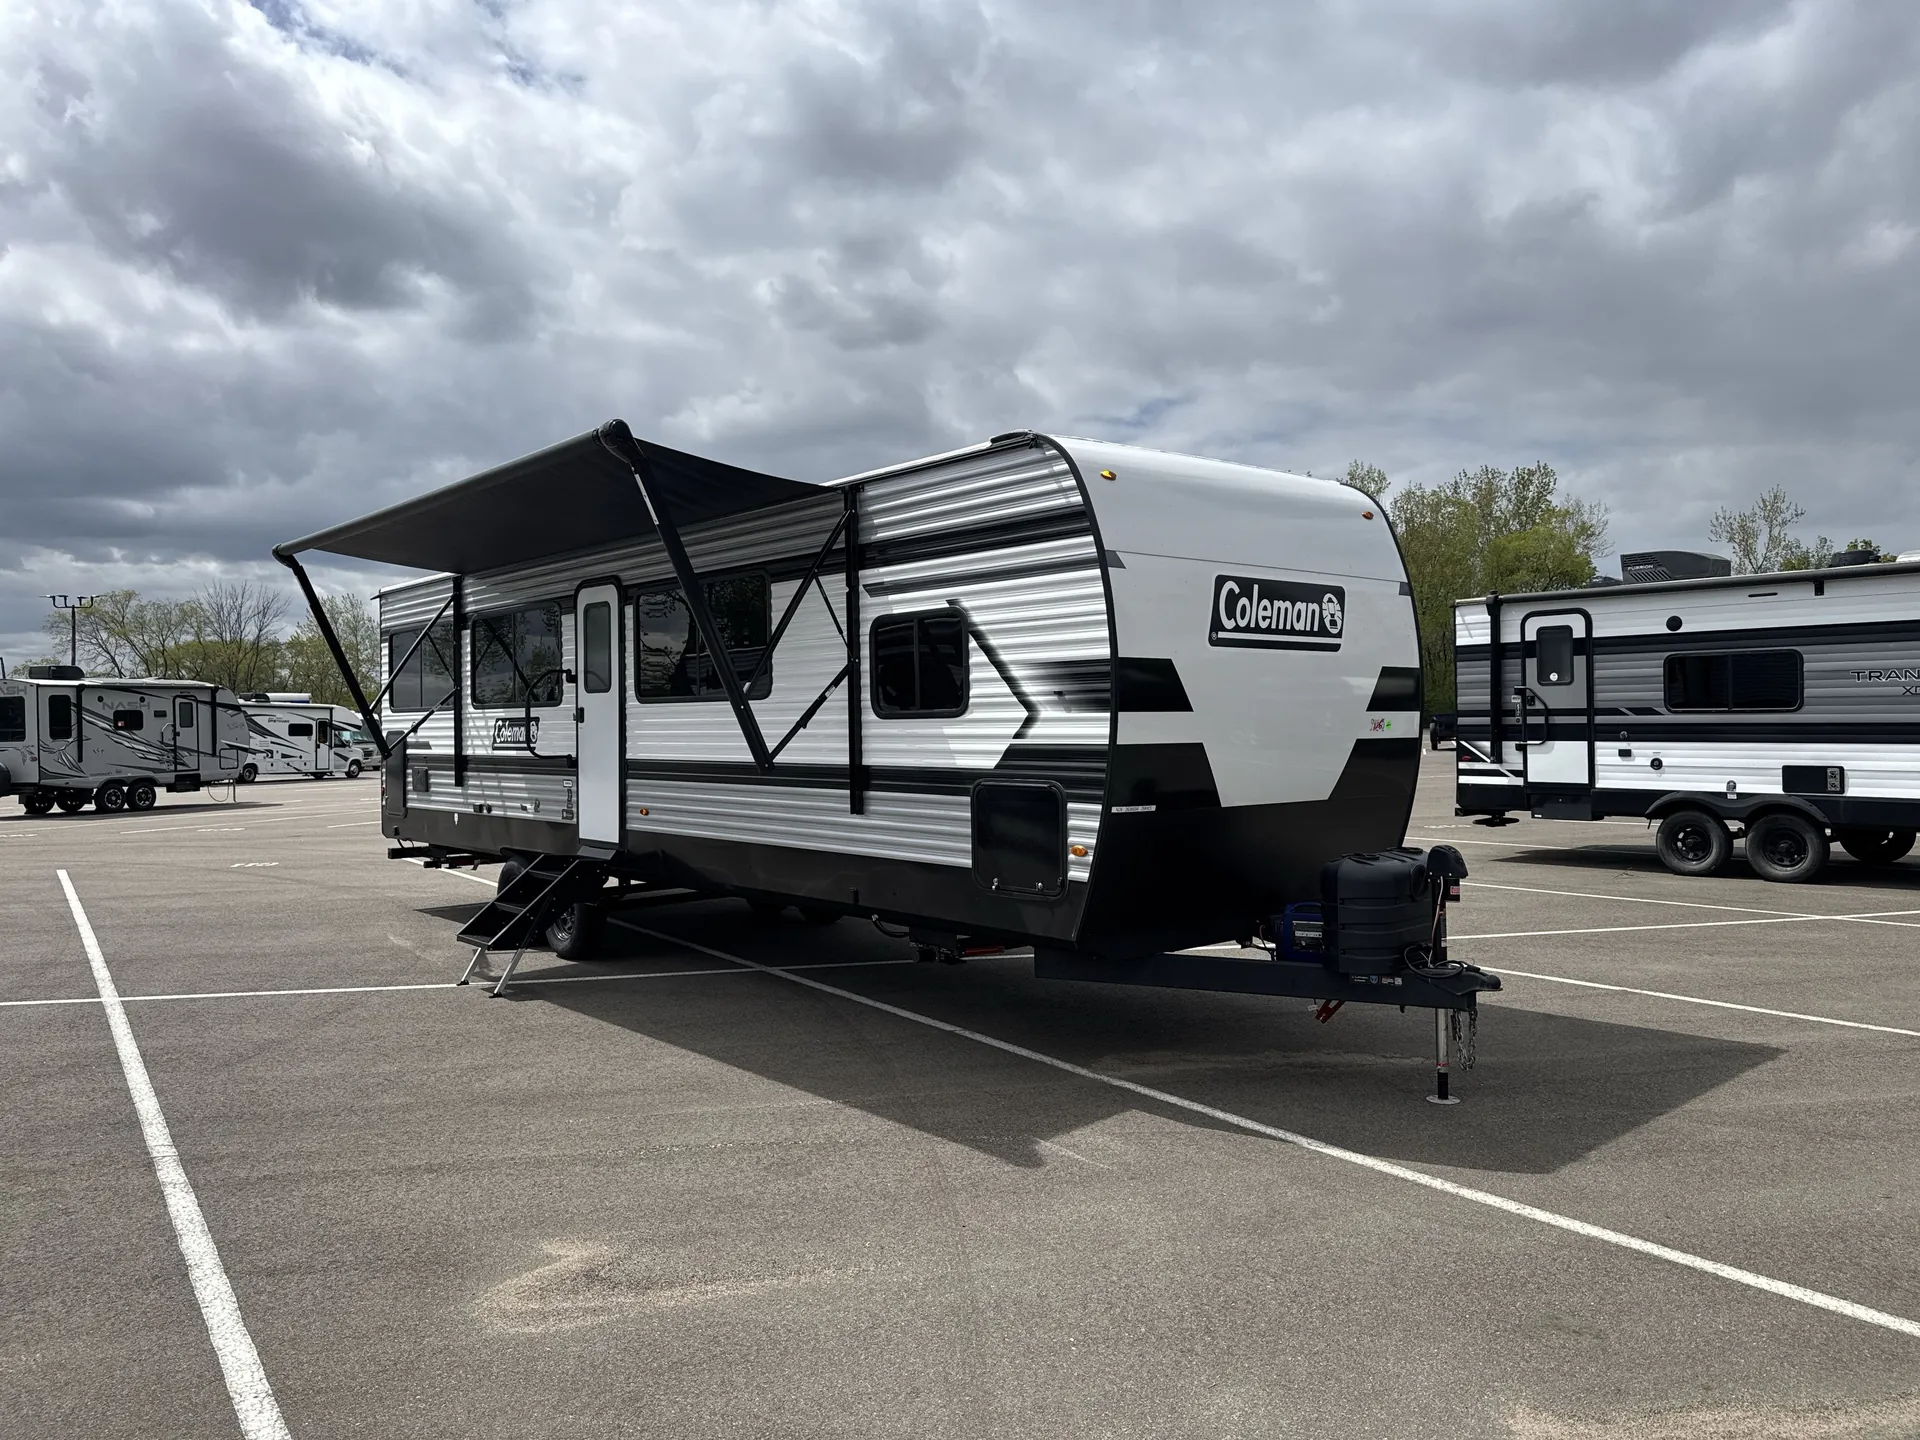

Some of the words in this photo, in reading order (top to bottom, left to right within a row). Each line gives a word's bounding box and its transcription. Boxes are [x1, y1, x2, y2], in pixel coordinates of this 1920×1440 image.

[1219, 580, 1320, 632] Coleman
[102, 701, 151, 711] NASH
[495, 720, 526, 743] Colema
